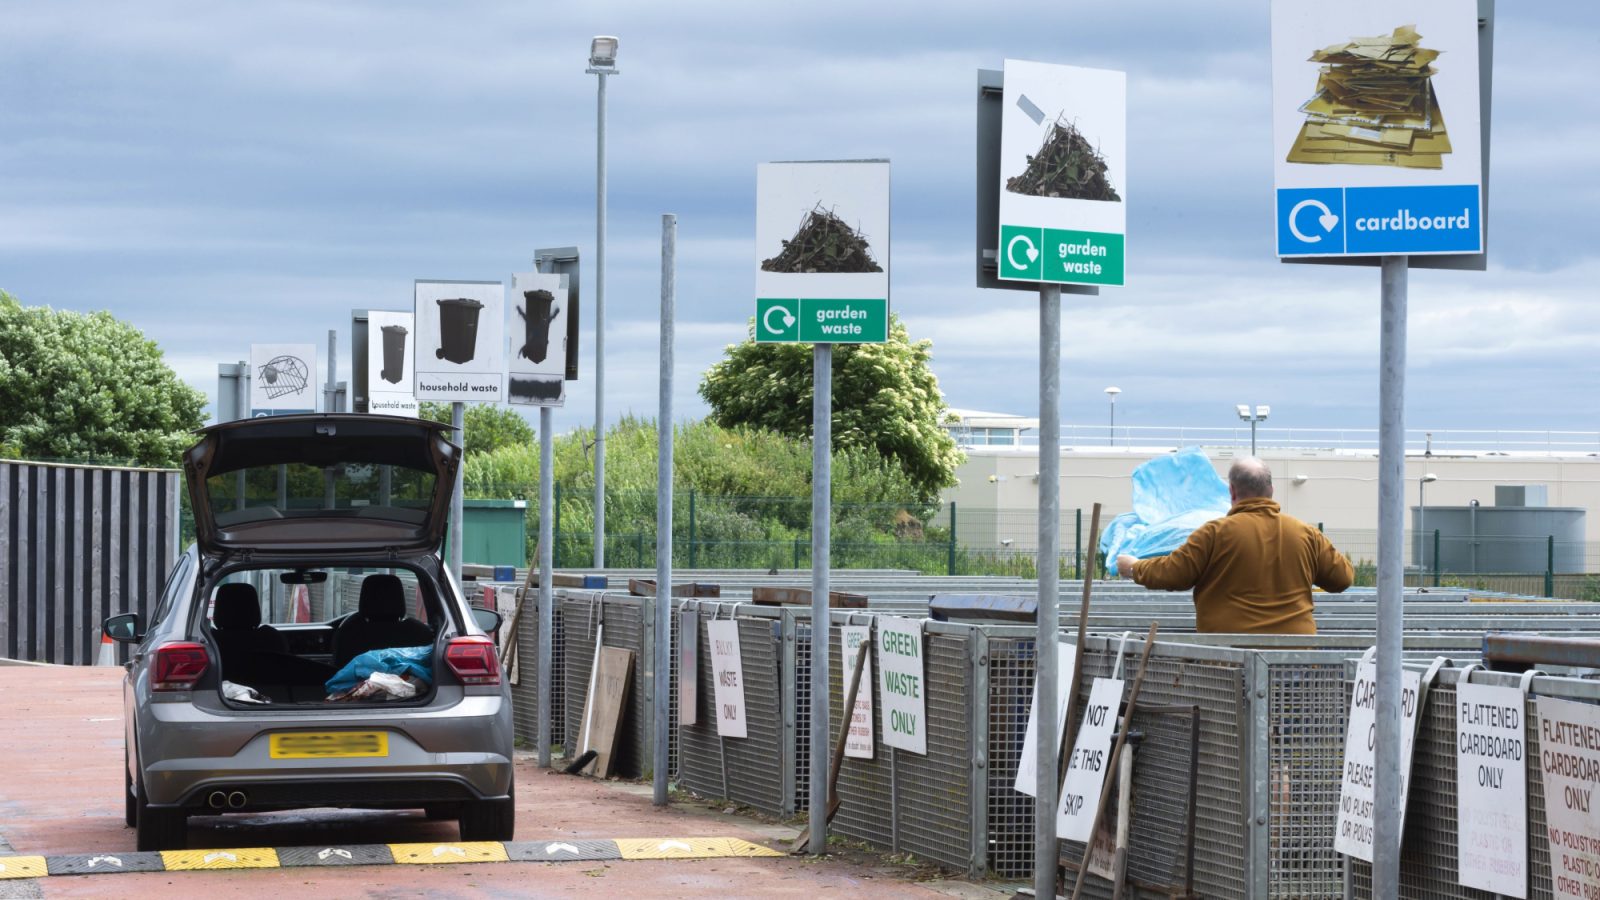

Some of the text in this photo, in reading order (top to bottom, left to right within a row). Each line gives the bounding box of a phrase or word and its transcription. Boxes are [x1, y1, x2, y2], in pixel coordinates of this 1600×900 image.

[1356, 207, 1469, 232] cardboard
[1058, 238, 1106, 258] garden
[1063, 261, 1102, 275] waste
[816, 304, 867, 322] garden
[821, 323, 862, 334] waste
[420, 381, 498, 392] household waste
[372, 400, 399, 410] household
[882, 630, 918, 657] GREEN
[719, 671, 737, 687] WASTE
[884, 670, 919, 698] WASTE
[1356, 678, 1415, 718] CARRD
[724, 704, 737, 720] ONLY
[891, 709, 916, 736] ONLY
[1087, 704, 1109, 727] NOT
[1462, 702, 1518, 729] FLATTENED
[1460, 732, 1521, 761] CARDBOARD
[1081, 749, 1103, 772] THIS
[1543, 749, 1600, 784] CARDBOAR
[1347, 761, 1373, 788] PLEASE
[1478, 764, 1503, 789] ONLY
[1064, 793, 1083, 816] SKIP
[1342, 795, 1374, 820] NO PLAST
[1565, 785, 1590, 813] ONLY
[1342, 819, 1351, 838] OR
[1550, 828, 1560, 845] NO
[1563, 854, 1592, 876] PLASTIC
[1558, 876, 1581, 896] OTHER
